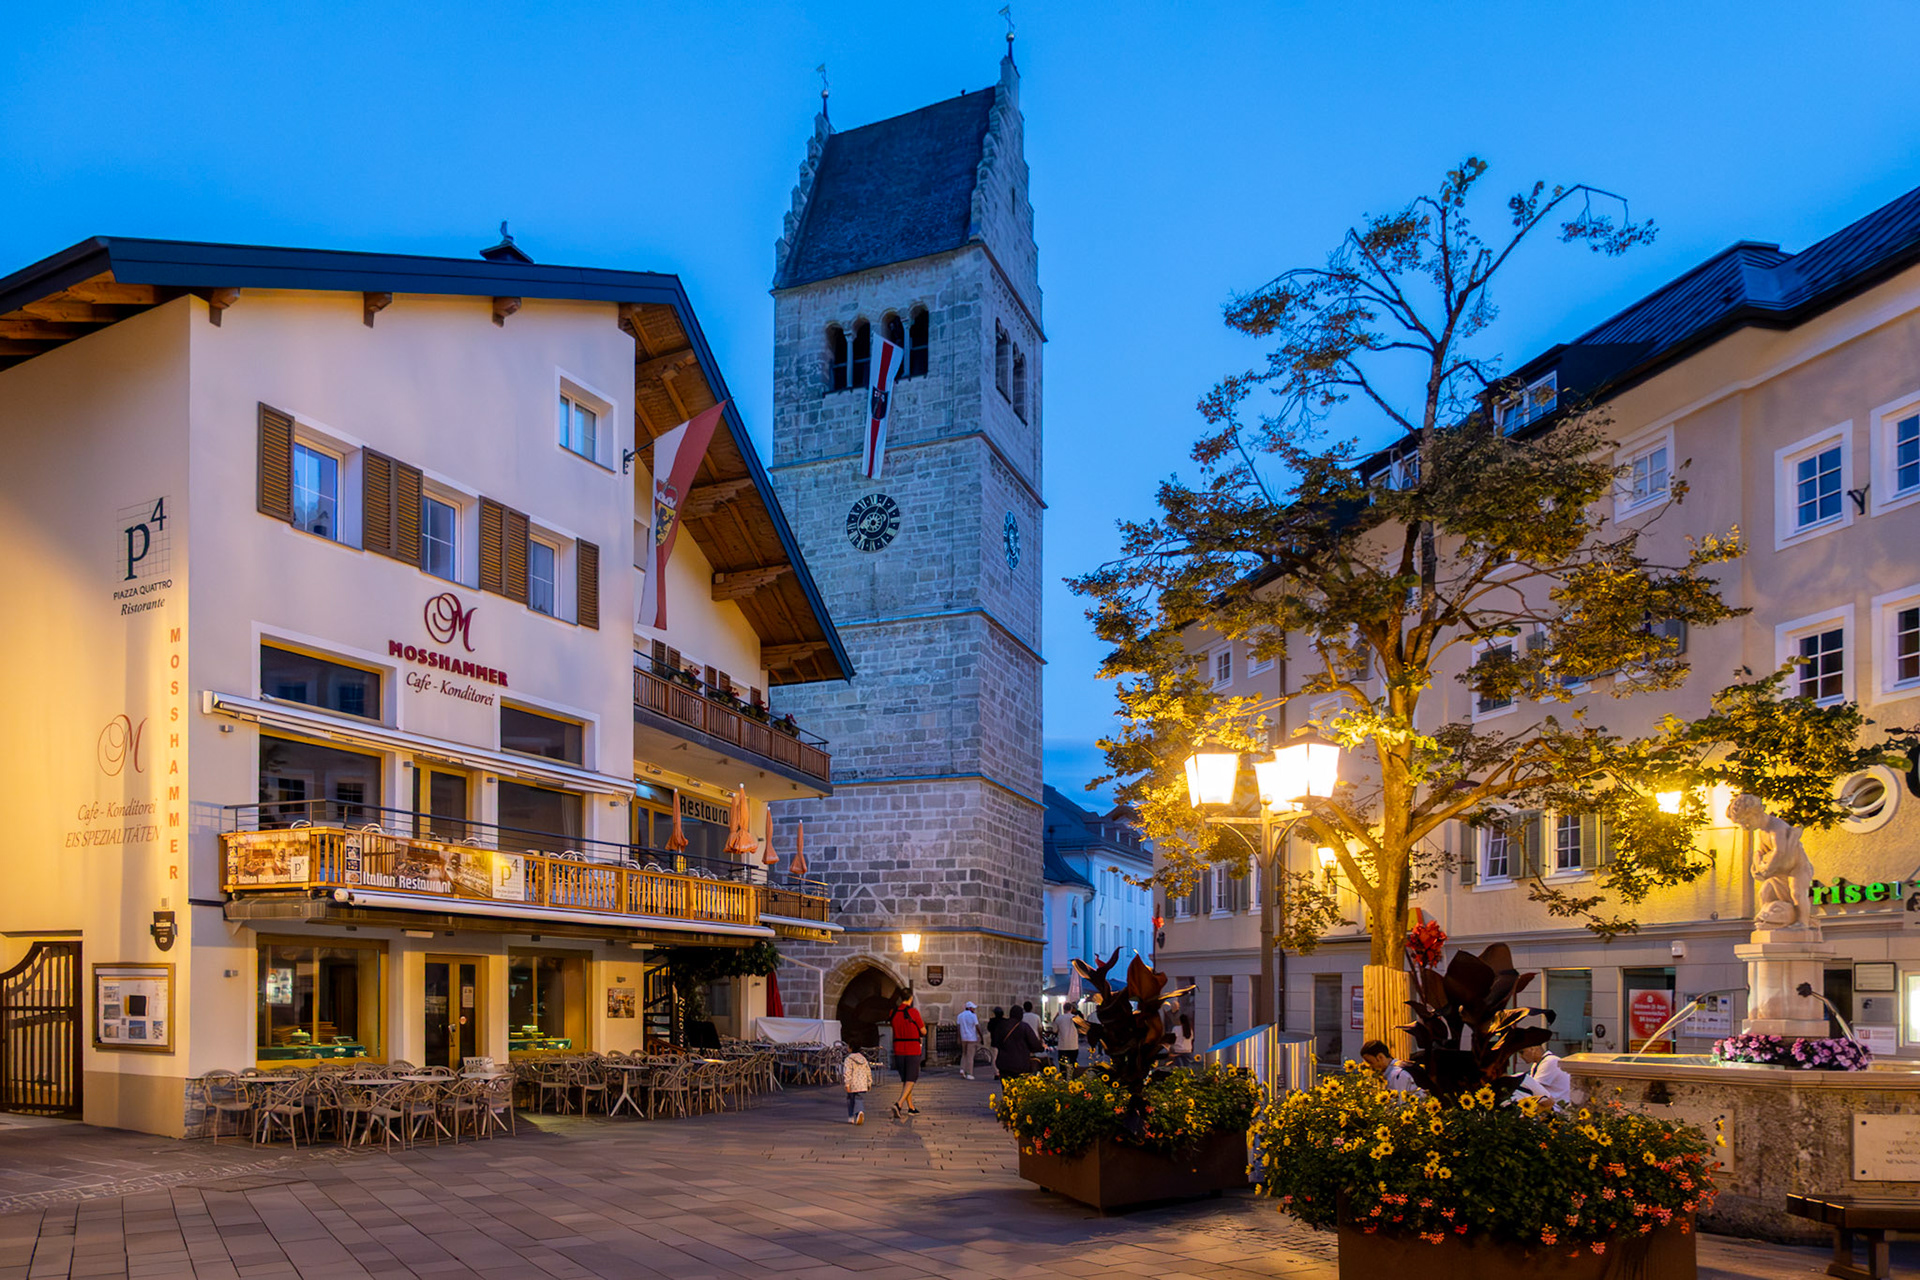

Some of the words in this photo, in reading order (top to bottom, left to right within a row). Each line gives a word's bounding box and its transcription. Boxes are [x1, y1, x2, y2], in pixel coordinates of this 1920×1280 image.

[113, 587, 138, 600] PIAZZA
[139, 579, 173, 595] QUATTRO
[121, 598, 166, 616] Ristorante
[388, 640, 509, 687] MOSSHAMMER
[406, 671, 432, 693] Cafe
[440, 680, 495, 706] Konditorei
[169, 627, 181, 880] MOSSHAMMER
[78, 801, 99, 826] Cafe
[106, 798, 158, 818] Konditorei
[680, 795, 729, 825] Restaura
[65, 831, 82, 848] EIS
[81, 824, 162, 847] SPEZIALITÄTEN
[363, 871, 396, 888] Italian
[399, 875, 452, 893] Restaurant
